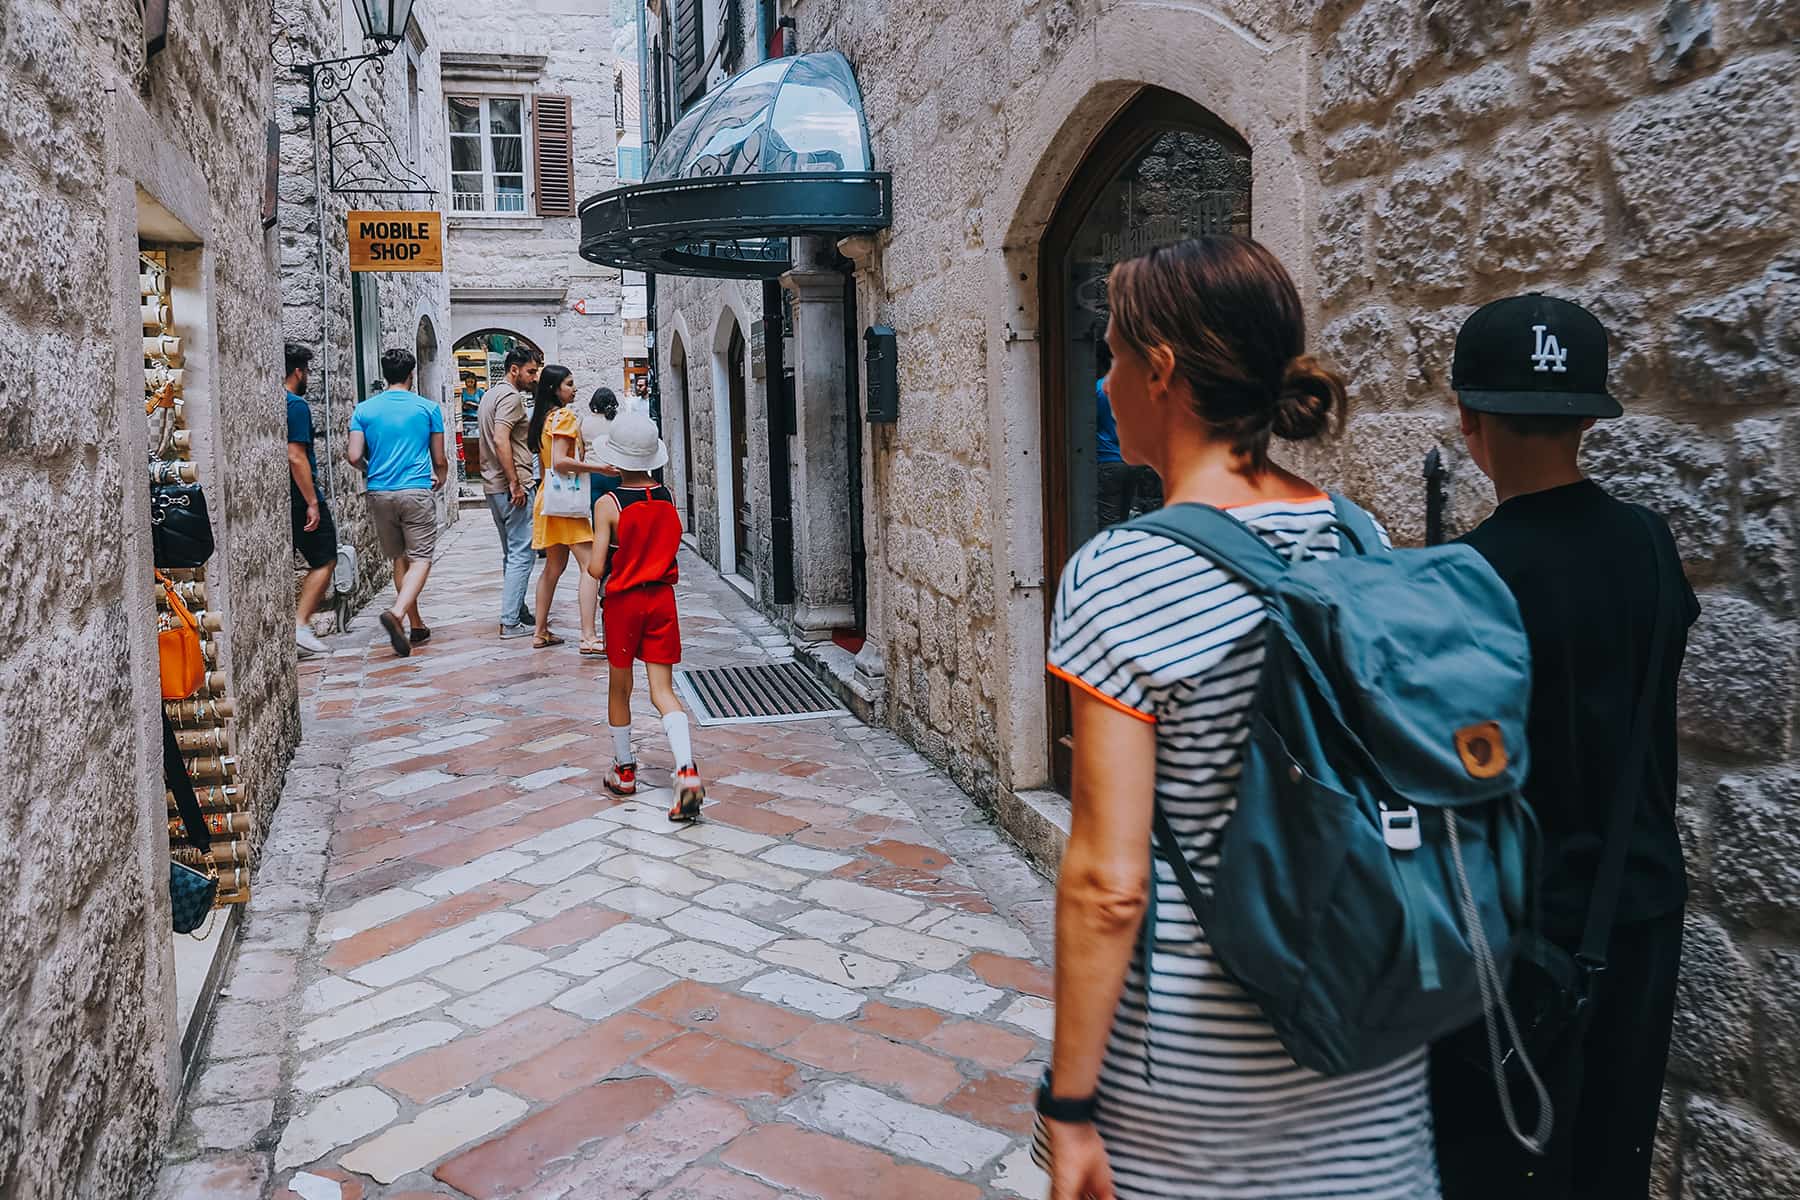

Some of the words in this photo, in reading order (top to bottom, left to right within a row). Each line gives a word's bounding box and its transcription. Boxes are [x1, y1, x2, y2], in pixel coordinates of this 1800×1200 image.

[360, 222, 430, 239] MOBILE
[370, 243, 421, 260] SHOP
[1531, 325, 1567, 371] LA
